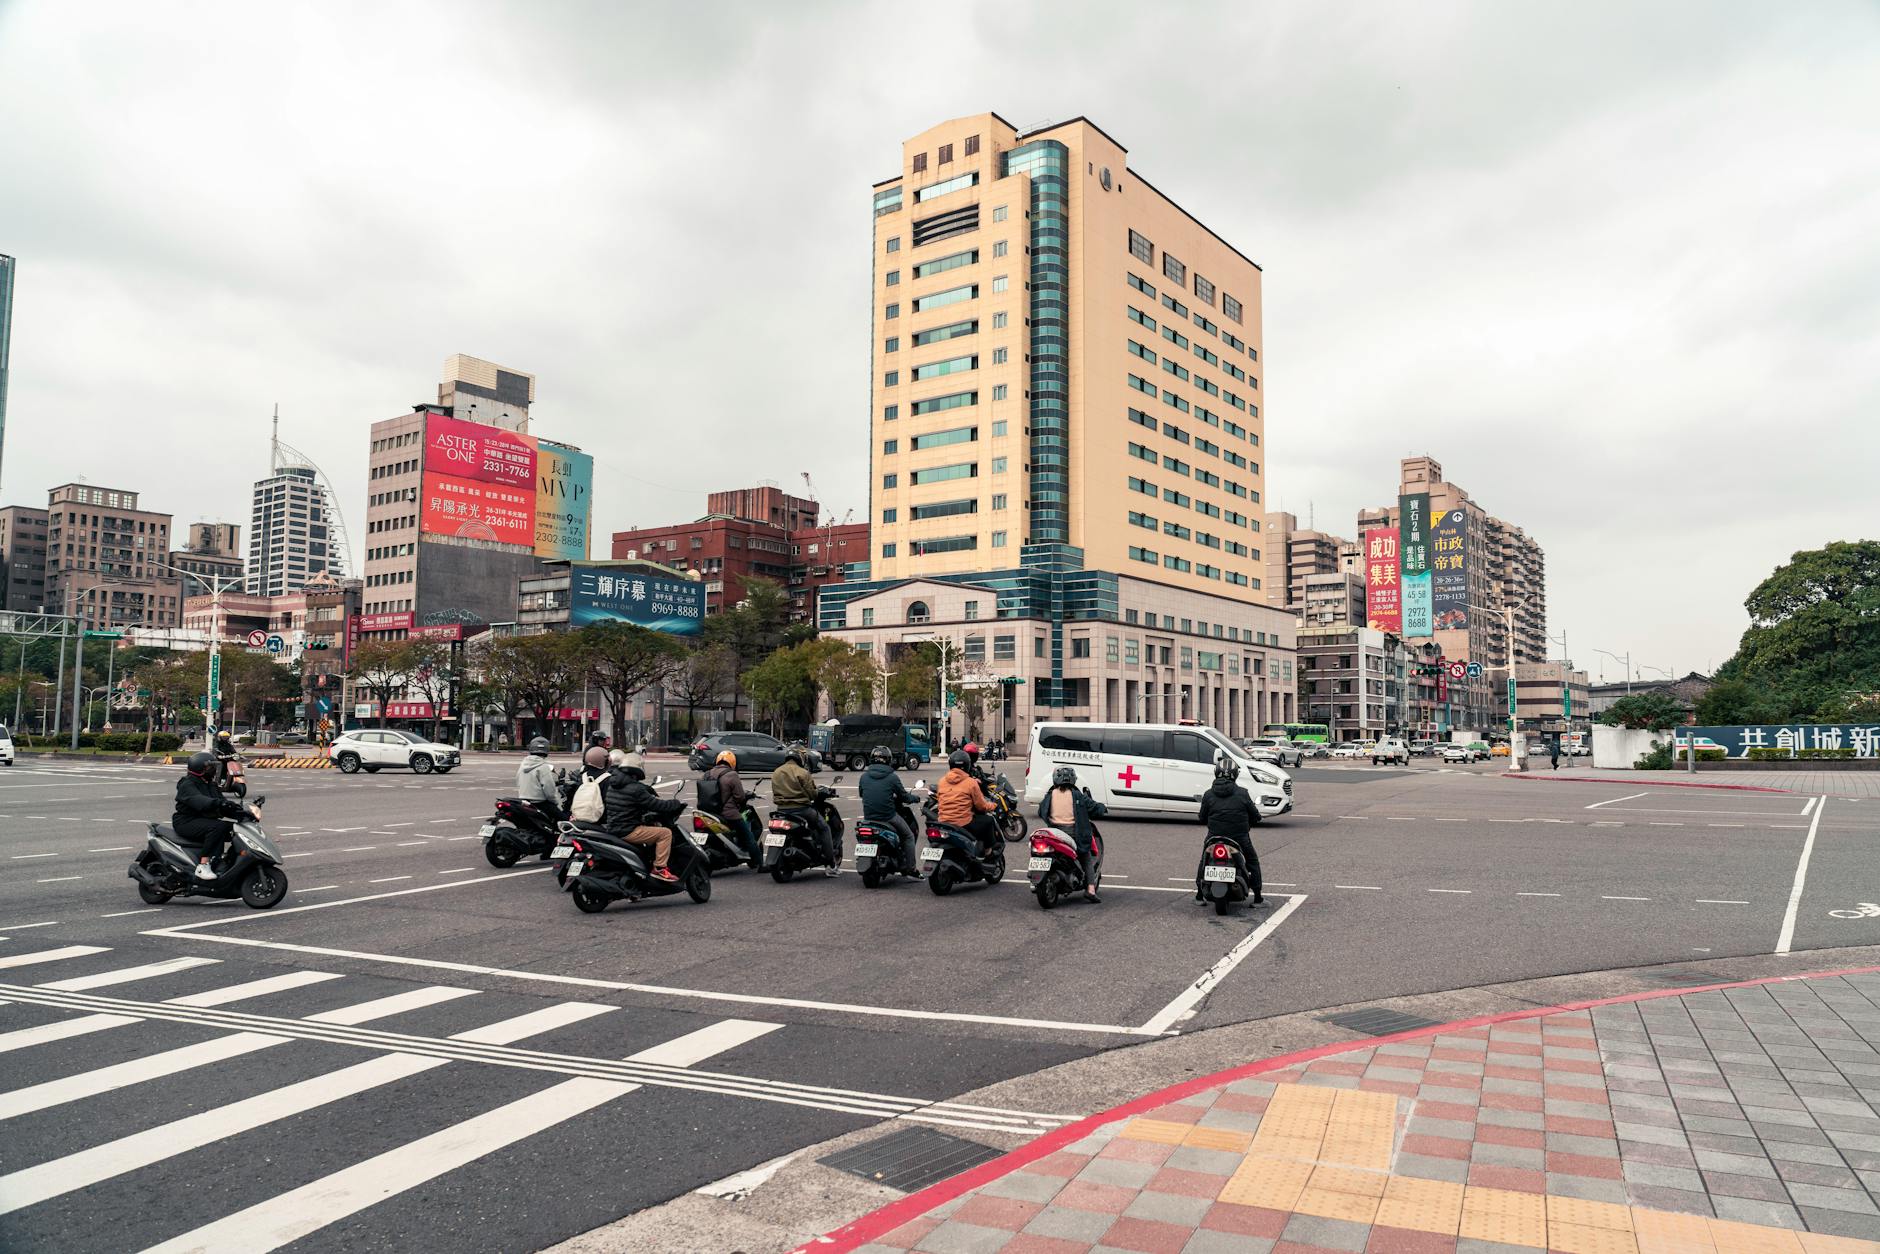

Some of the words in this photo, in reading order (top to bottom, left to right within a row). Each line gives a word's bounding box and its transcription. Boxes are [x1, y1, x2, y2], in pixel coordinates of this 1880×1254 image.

[437, 434, 476, 452] ASTER
[447, 448, 476, 463] ONE
[484, 460, 529, 478] 2331-7766
[541, 477, 584, 500] MVP
[430, 497, 480, 518] 昇陽承光
[485, 515, 527, 529] 2361-6111
[1370, 536, 1395, 558] 成功
[1434, 536, 1464, 552] 市政
[1434, 554, 1463, 570] 帝寶
[1371, 564, 1396, 586] 集美
[580, 574, 646, 601] 三輝序慕
[651, 602, 698, 618] 8969-8888
[1408, 607, 1426, 617] 2972
[1408, 618, 1426, 627] 8688
